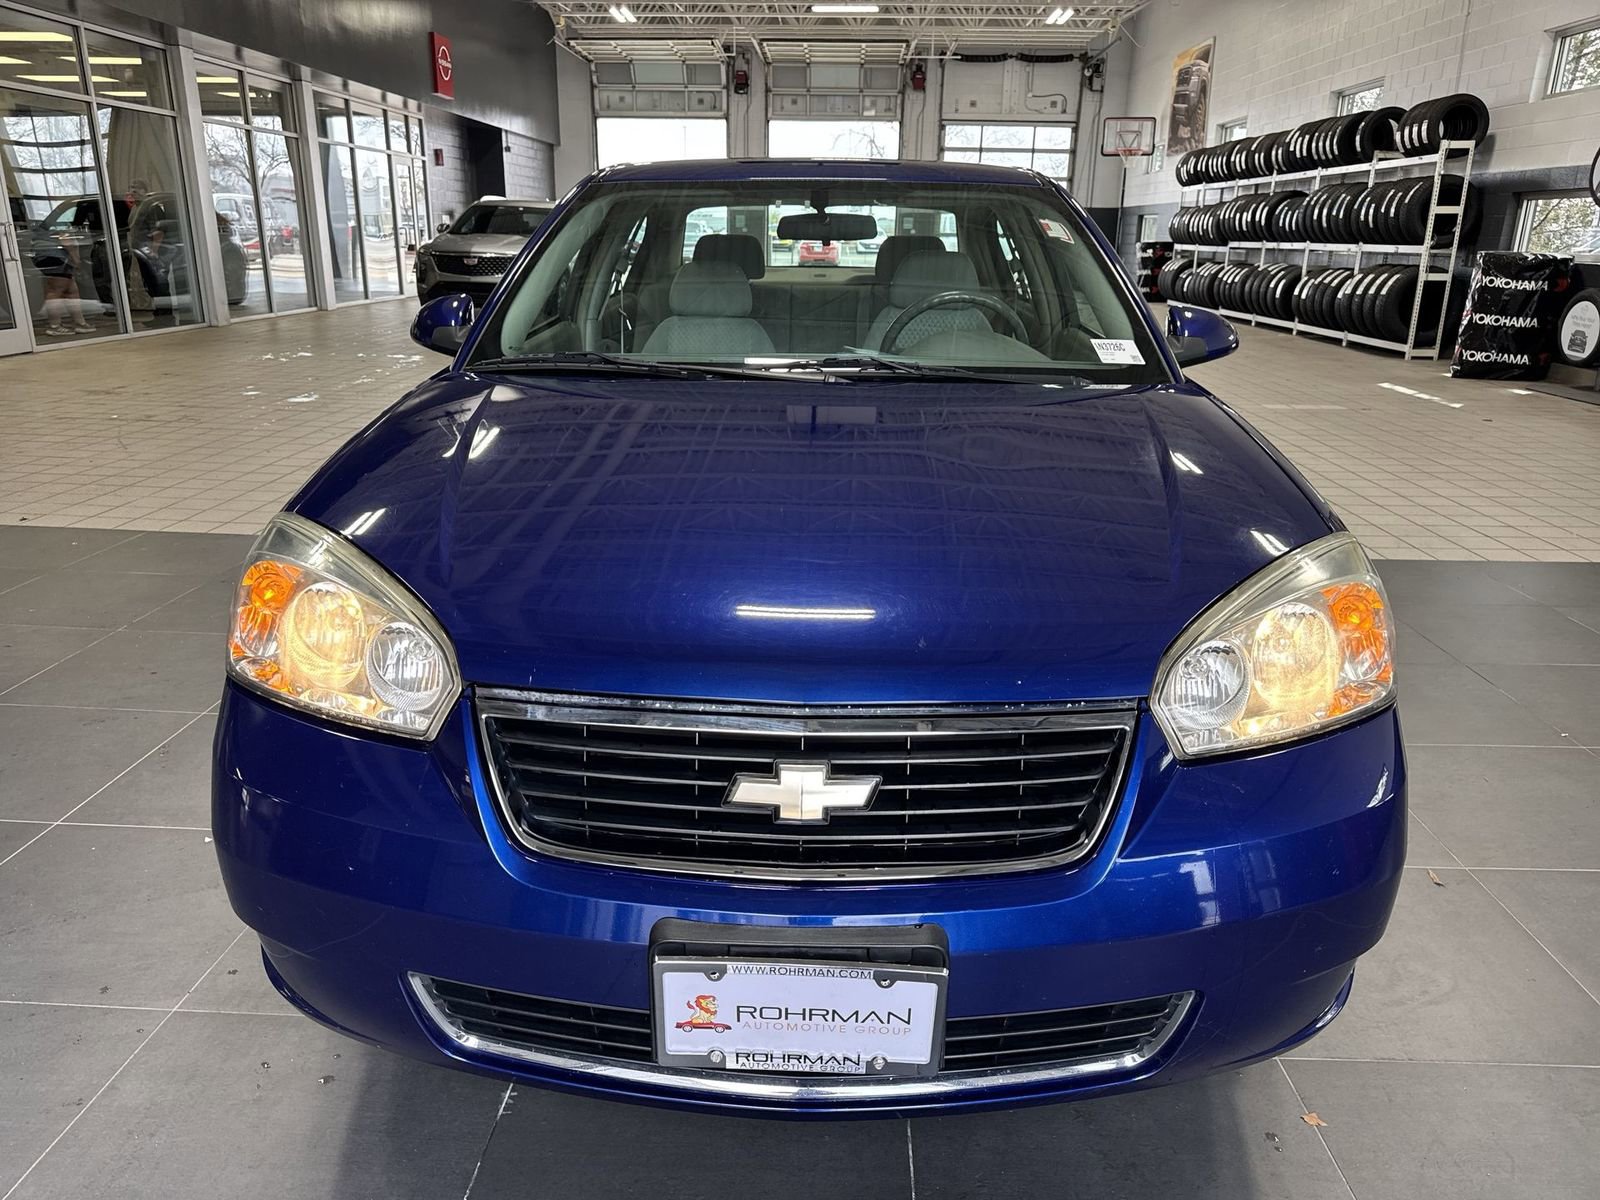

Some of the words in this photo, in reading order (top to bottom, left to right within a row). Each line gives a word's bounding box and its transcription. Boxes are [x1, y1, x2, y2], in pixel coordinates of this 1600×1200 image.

[1481, 275, 1549, 291] YOKOHAMA
[1471, 312, 1539, 328] YOKOHAMA
[1462, 349, 1530, 365] YOKOHAMA
[732, 965, 872, 979] WWW.ROHRMAN.COM
[736, 1005, 912, 1025] ROHRMAN
[742, 1021, 847, 1033] AUTOMOTIVE
[854, 1026, 912, 1036] GROUP
[735, 1052, 861, 1066] ROHRMAN
[740, 1062, 815, 1072] AUTOMOTIVE
[819, 1065, 861, 1073] GROUP
